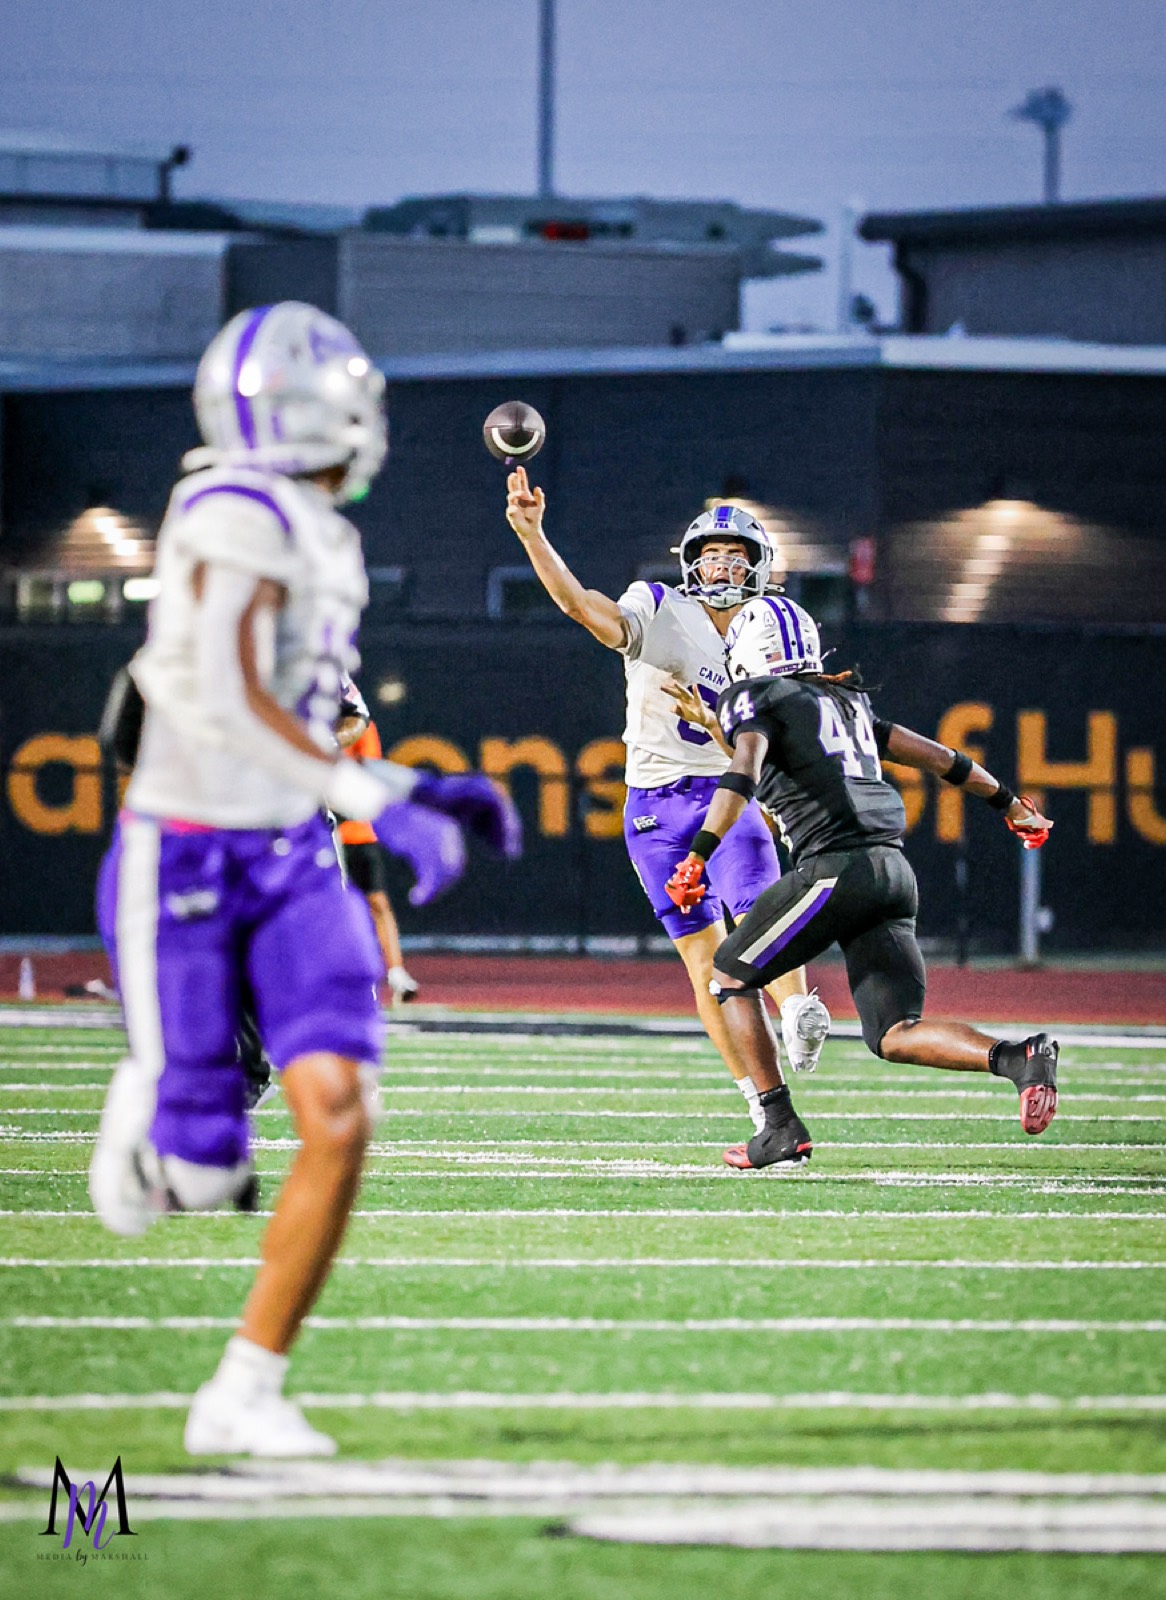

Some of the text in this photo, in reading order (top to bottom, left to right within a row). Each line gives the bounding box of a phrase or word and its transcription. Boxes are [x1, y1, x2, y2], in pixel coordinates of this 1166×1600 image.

[698, 666, 726, 686] CAIN
[719, 690, 755, 734] 44
[817, 691, 883, 781] 44
